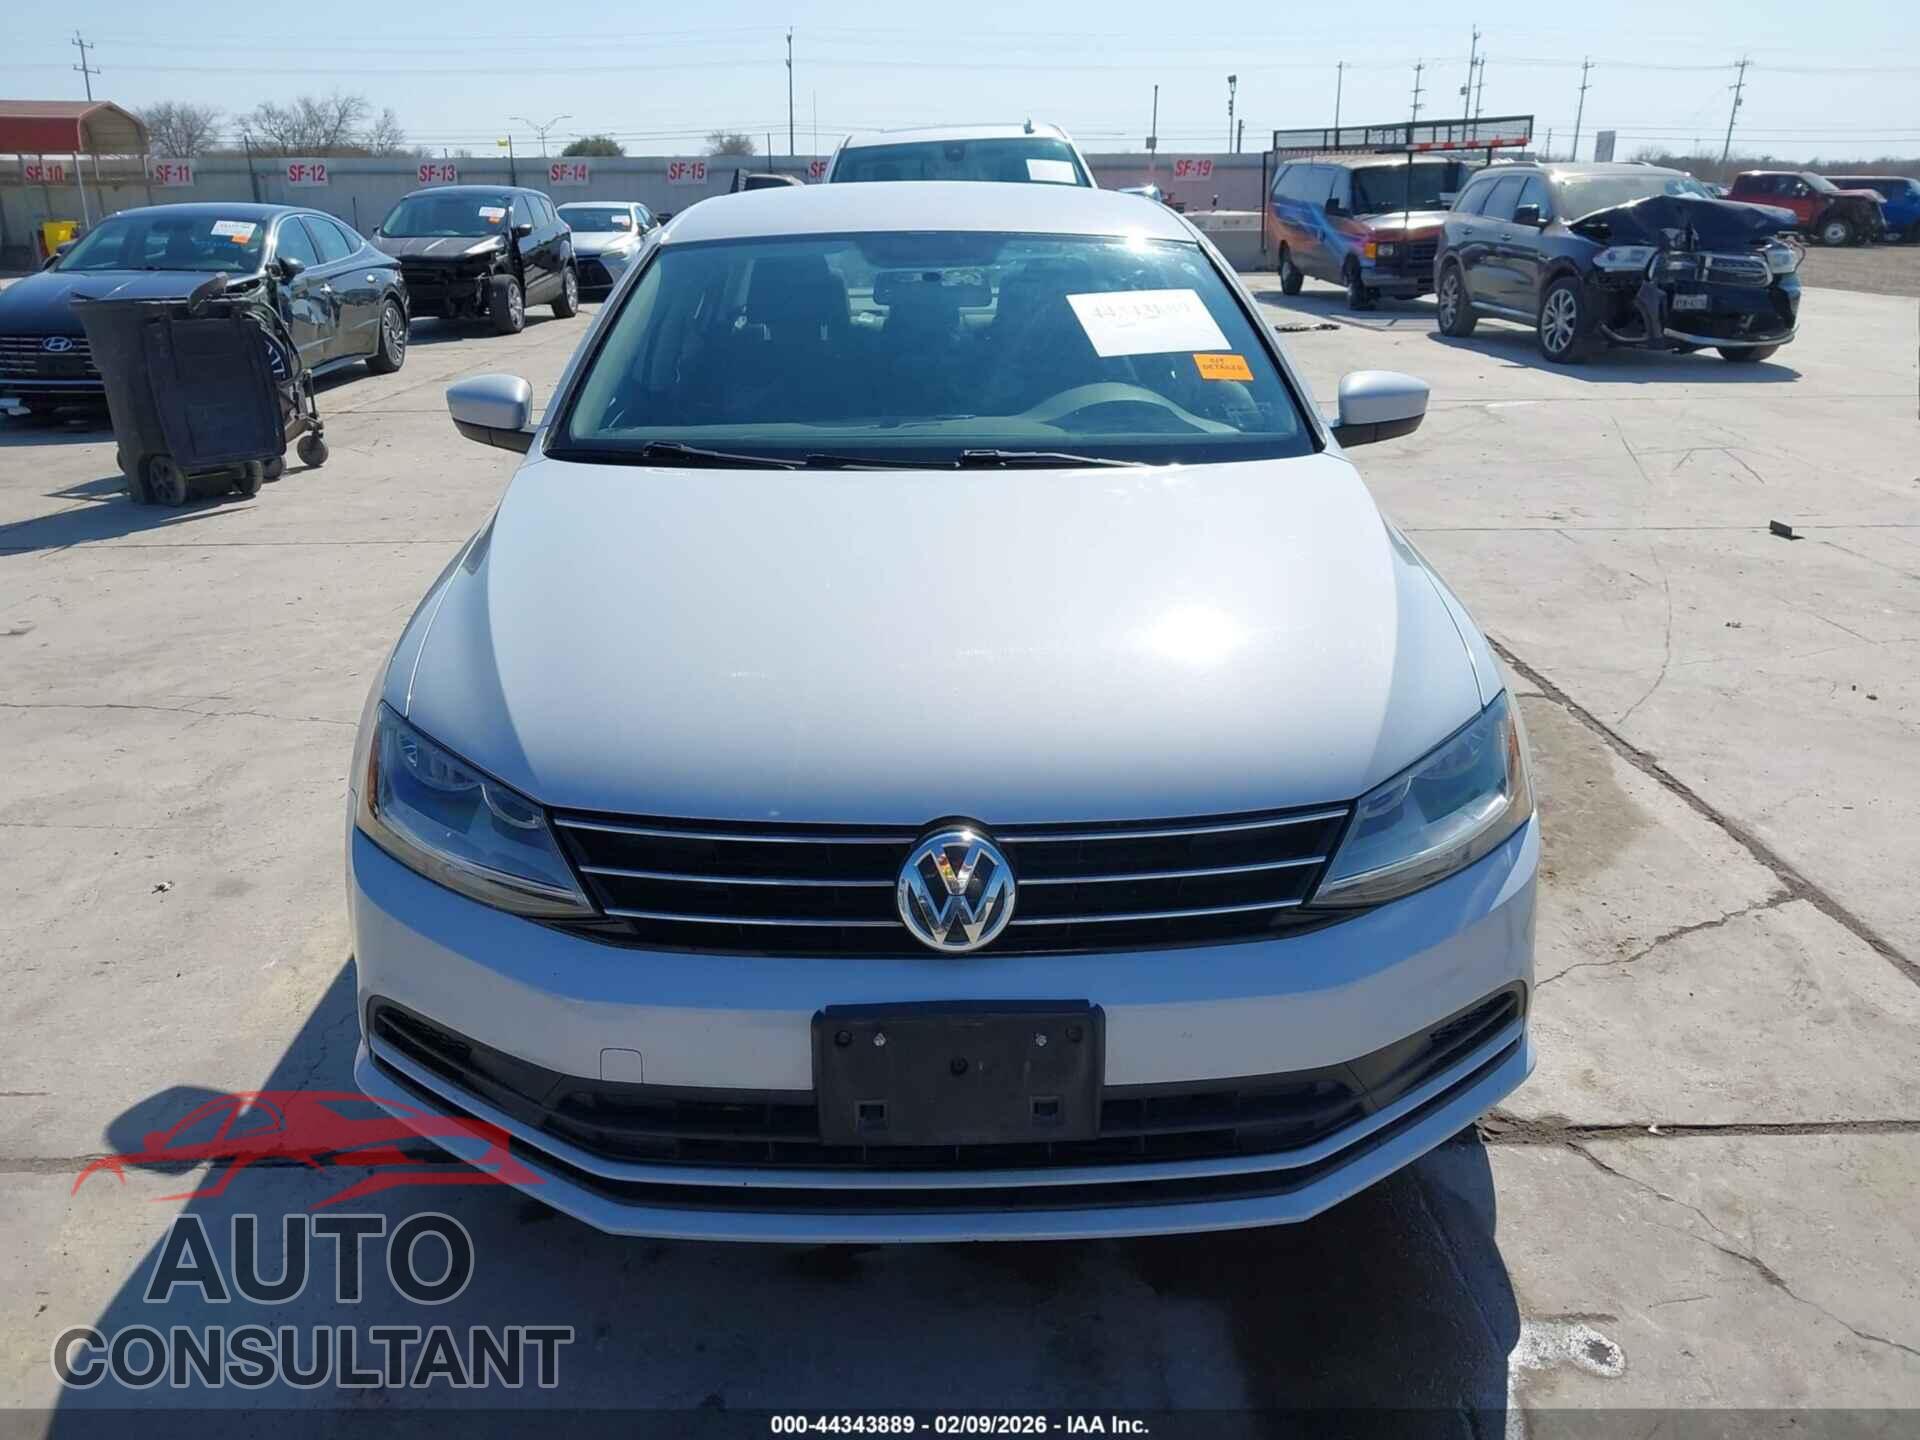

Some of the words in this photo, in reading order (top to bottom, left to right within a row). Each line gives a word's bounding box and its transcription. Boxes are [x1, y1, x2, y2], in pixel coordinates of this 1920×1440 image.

[156, 165, 190, 182] SF-11
[288, 164, 325, 182] SF-12
[419, 164, 455, 182] SF-13
[551, 164, 586, 181] SF-14
[669, 162, 704, 180] SF-15
[809, 160, 827, 178] SF
[1175, 159, 1212, 177] SF-19
